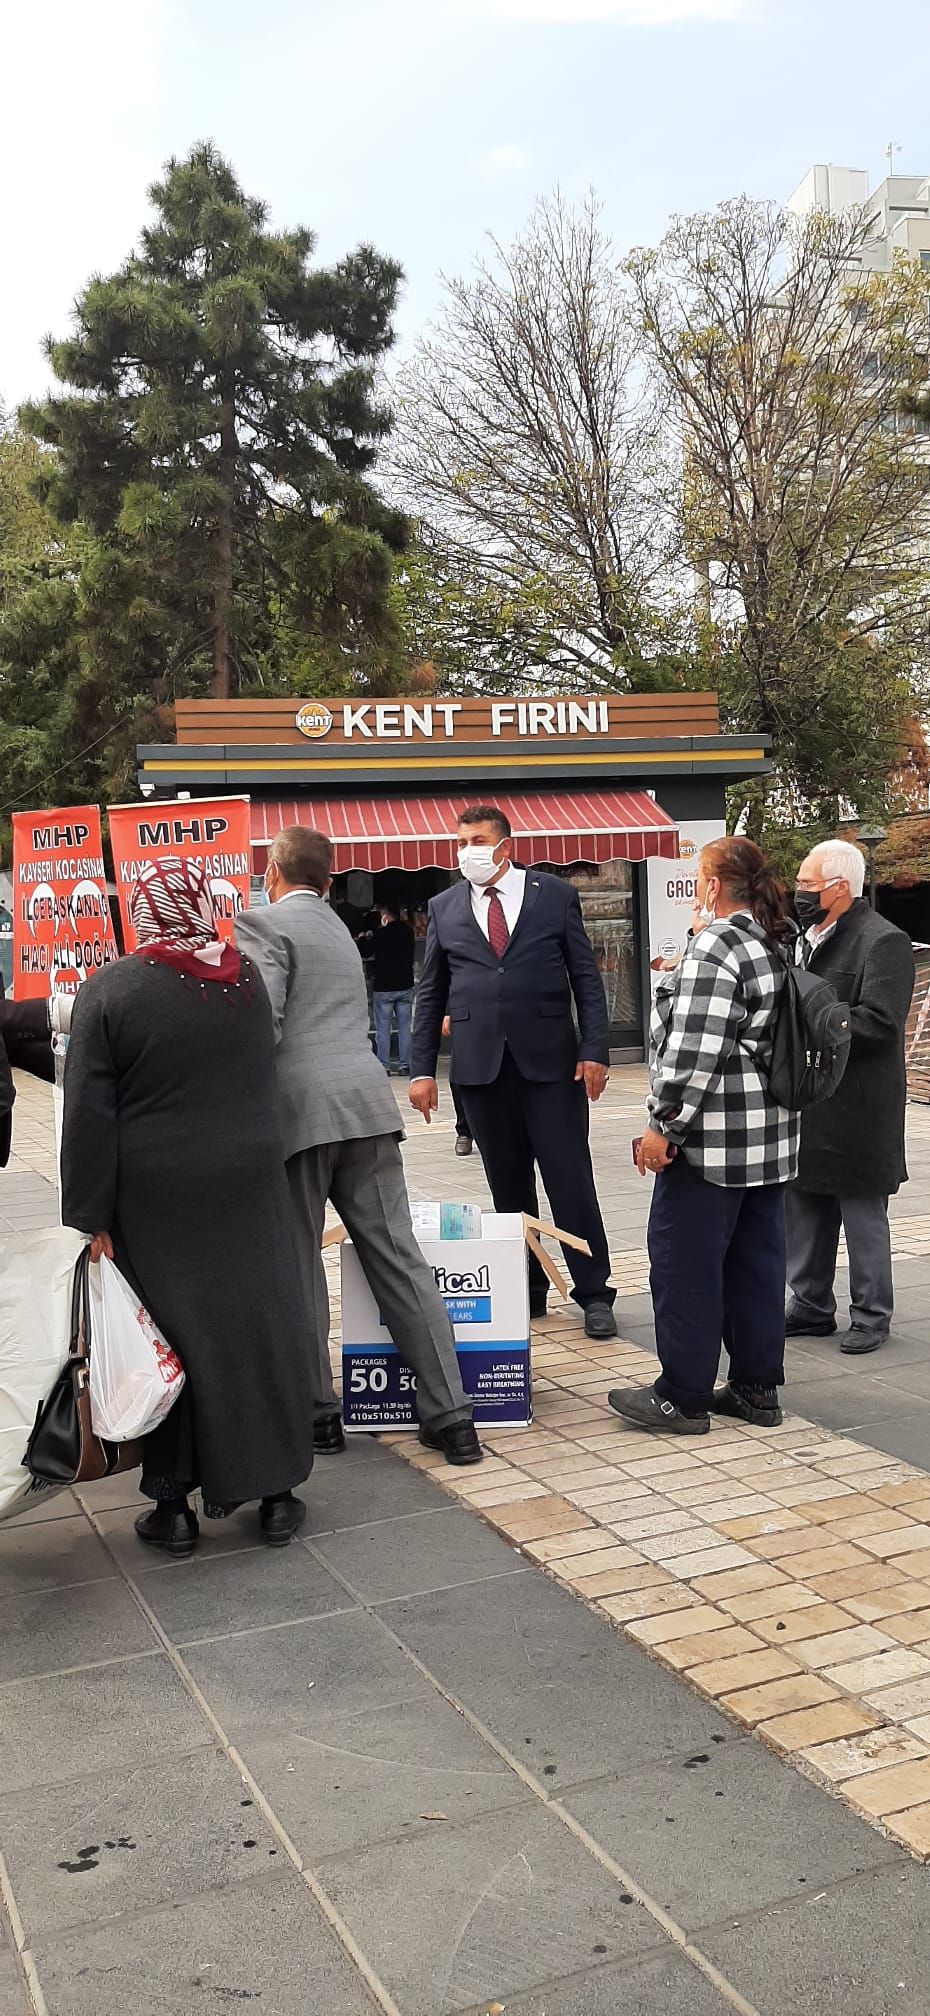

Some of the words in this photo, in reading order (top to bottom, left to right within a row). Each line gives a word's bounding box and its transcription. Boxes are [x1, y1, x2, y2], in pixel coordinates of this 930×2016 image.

[343, 703, 462, 738] KENT
[491, 701, 609, 735] FIRINI
[32, 824, 89, 850] MHP
[138, 817, 229, 847] MHP
[19, 855, 54, 883] KAYSERİ
[53, 934, 71, 969] ALİ
[456, 1300, 477, 1309] WITH
[351, 1358, 387, 1366] PACKAGES
[350, 1367, 387, 1392] 50
